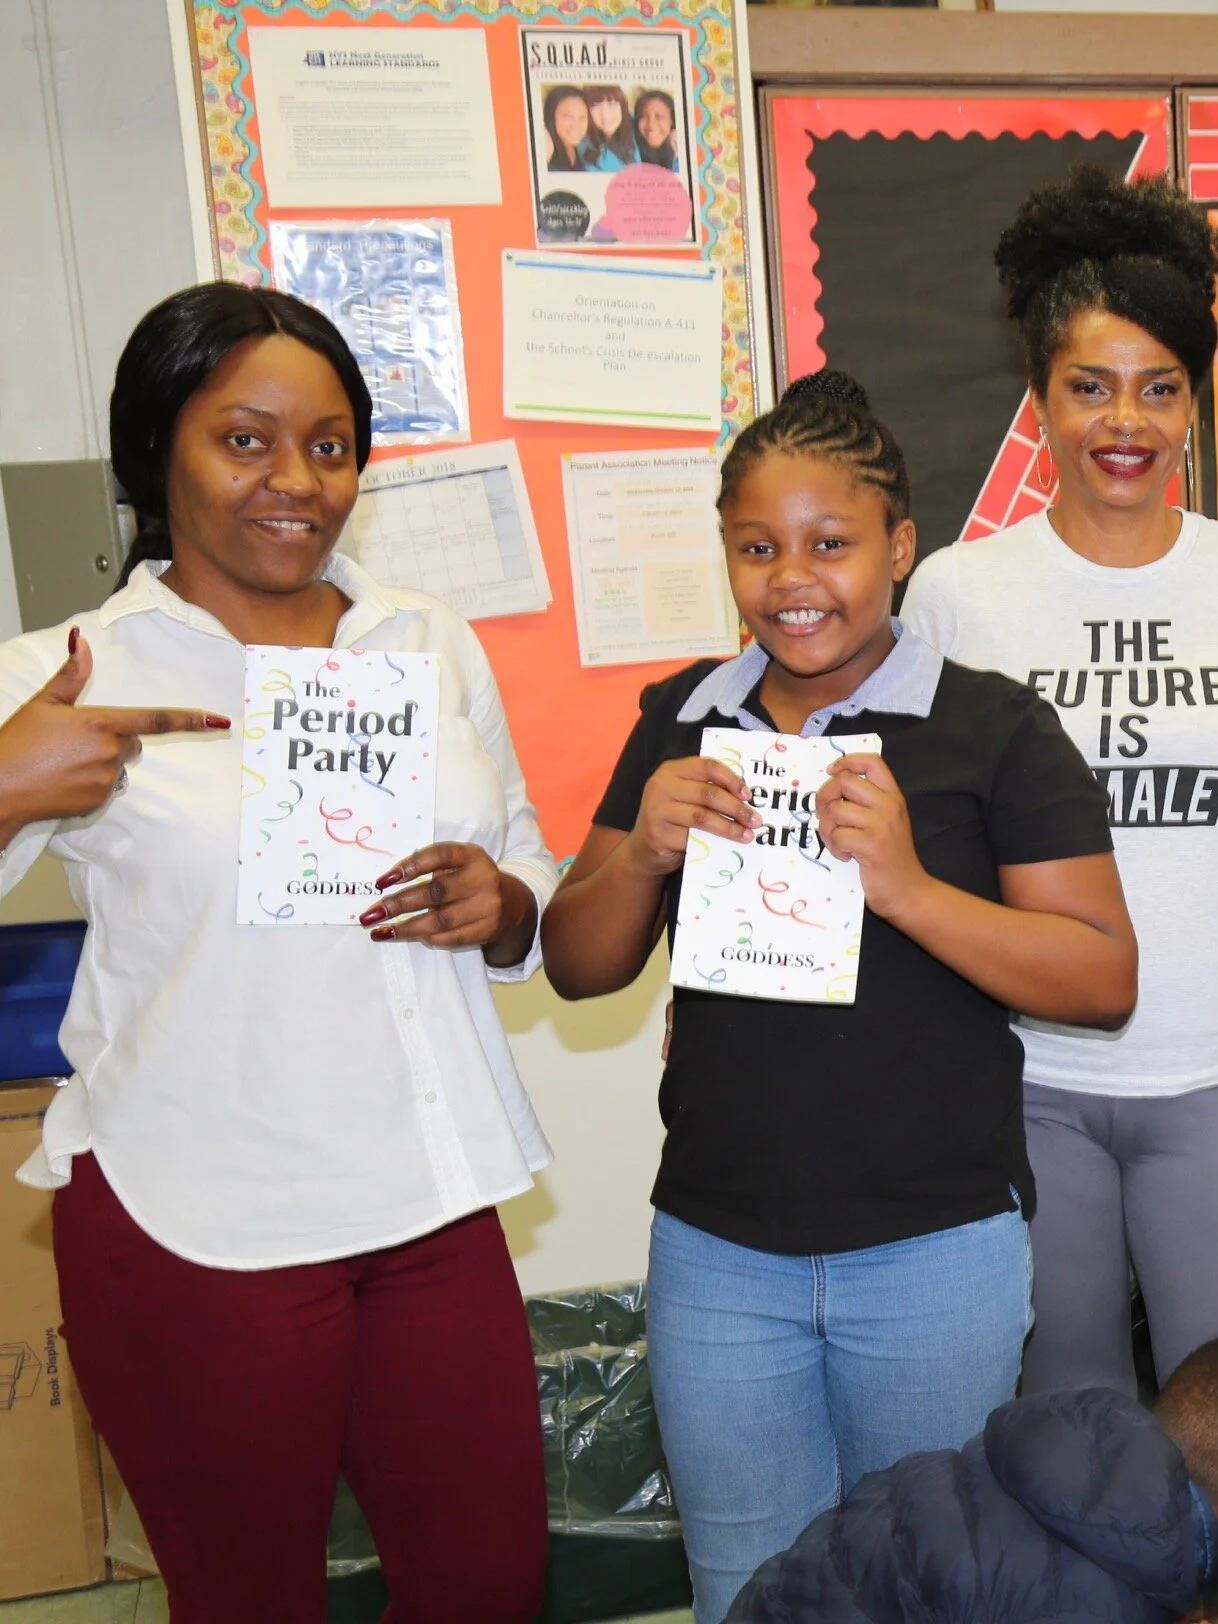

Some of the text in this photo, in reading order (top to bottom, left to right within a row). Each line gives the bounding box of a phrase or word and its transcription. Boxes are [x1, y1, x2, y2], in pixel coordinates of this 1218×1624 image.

[330, 58, 440, 69] LEARNING STANDARDS
[350, 51, 372, 59] Next
[374, 51, 424, 60] Generation
[639, 58, 664, 68] GROUP
[575, 294, 656, 312] Orientation on
[531, 308, 600, 323] Chancellor's
[603, 313, 662, 329] Regulation
[604, 331, 626, 342] and
[526, 341, 545, 353] the
[548, 342, 593, 356] School's
[596, 345, 625, 359] Crisis
[602, 359, 627, 372] Plan
[569, 456, 718, 472] Parent Association Meeting Notice
[366, 466, 427, 485] OCTOBER
[1083, 619, 1174, 662] THE
[302, 681, 341, 699] The
[272, 698, 418, 737] Period
[1099, 713, 1150, 758] IS
[287, 736, 397, 784] Party
[751, 759, 786, 777] The
[748, 779, 818, 813] erio
[755, 821, 827, 860] arty
[286, 881, 384, 896] GODDESS
[721, 946, 815, 968] GODDESS
[45, 1327, 61, 1407] Book Displays
